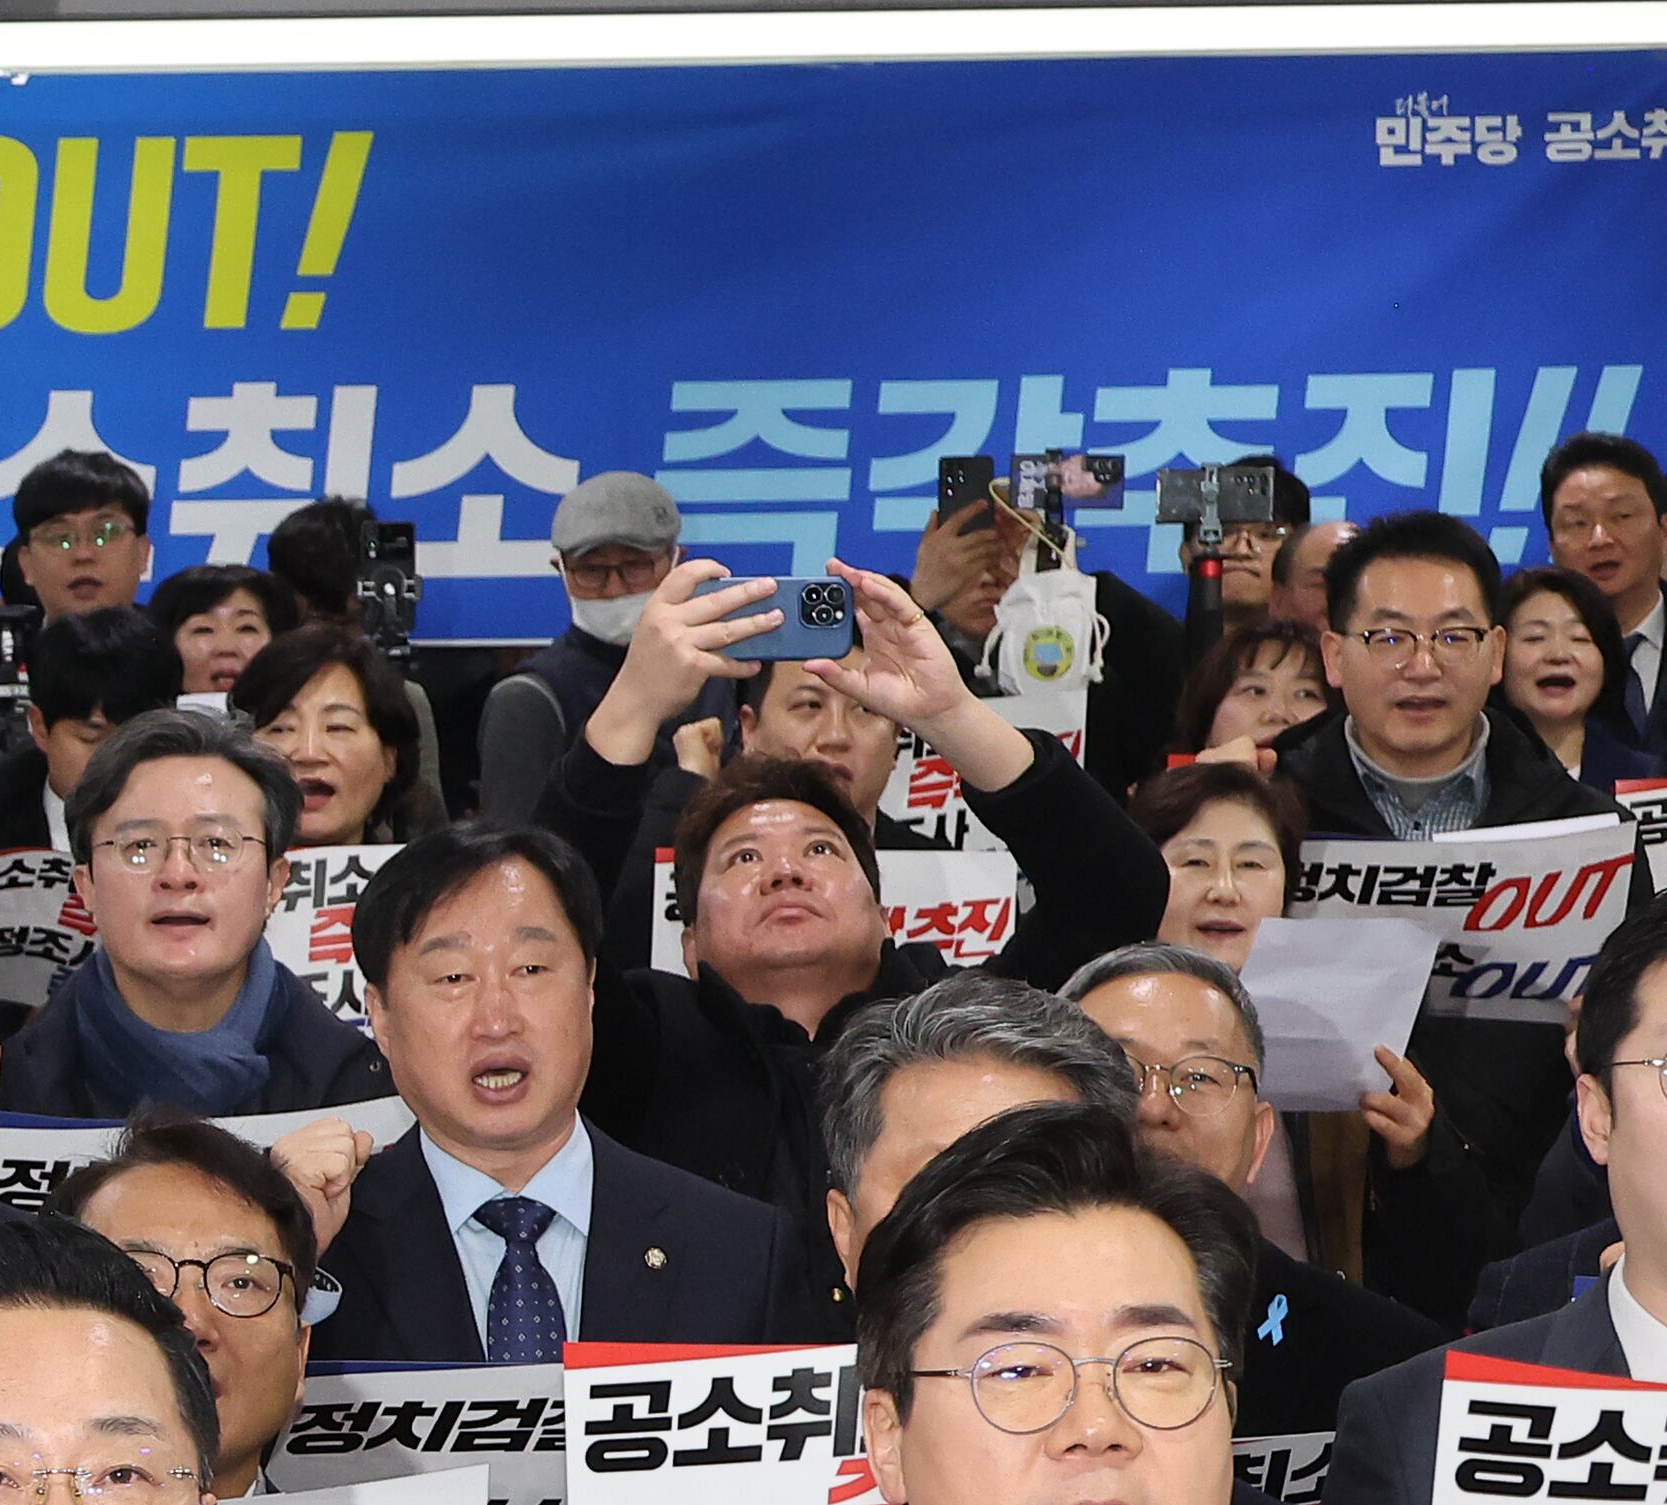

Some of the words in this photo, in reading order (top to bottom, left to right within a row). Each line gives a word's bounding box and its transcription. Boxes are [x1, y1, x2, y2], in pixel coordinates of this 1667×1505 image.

[1374, 113, 1523, 168] 민주당
[1463, 852, 1636, 932] OUT
[1455, 1401, 1667, 1503] 공소
